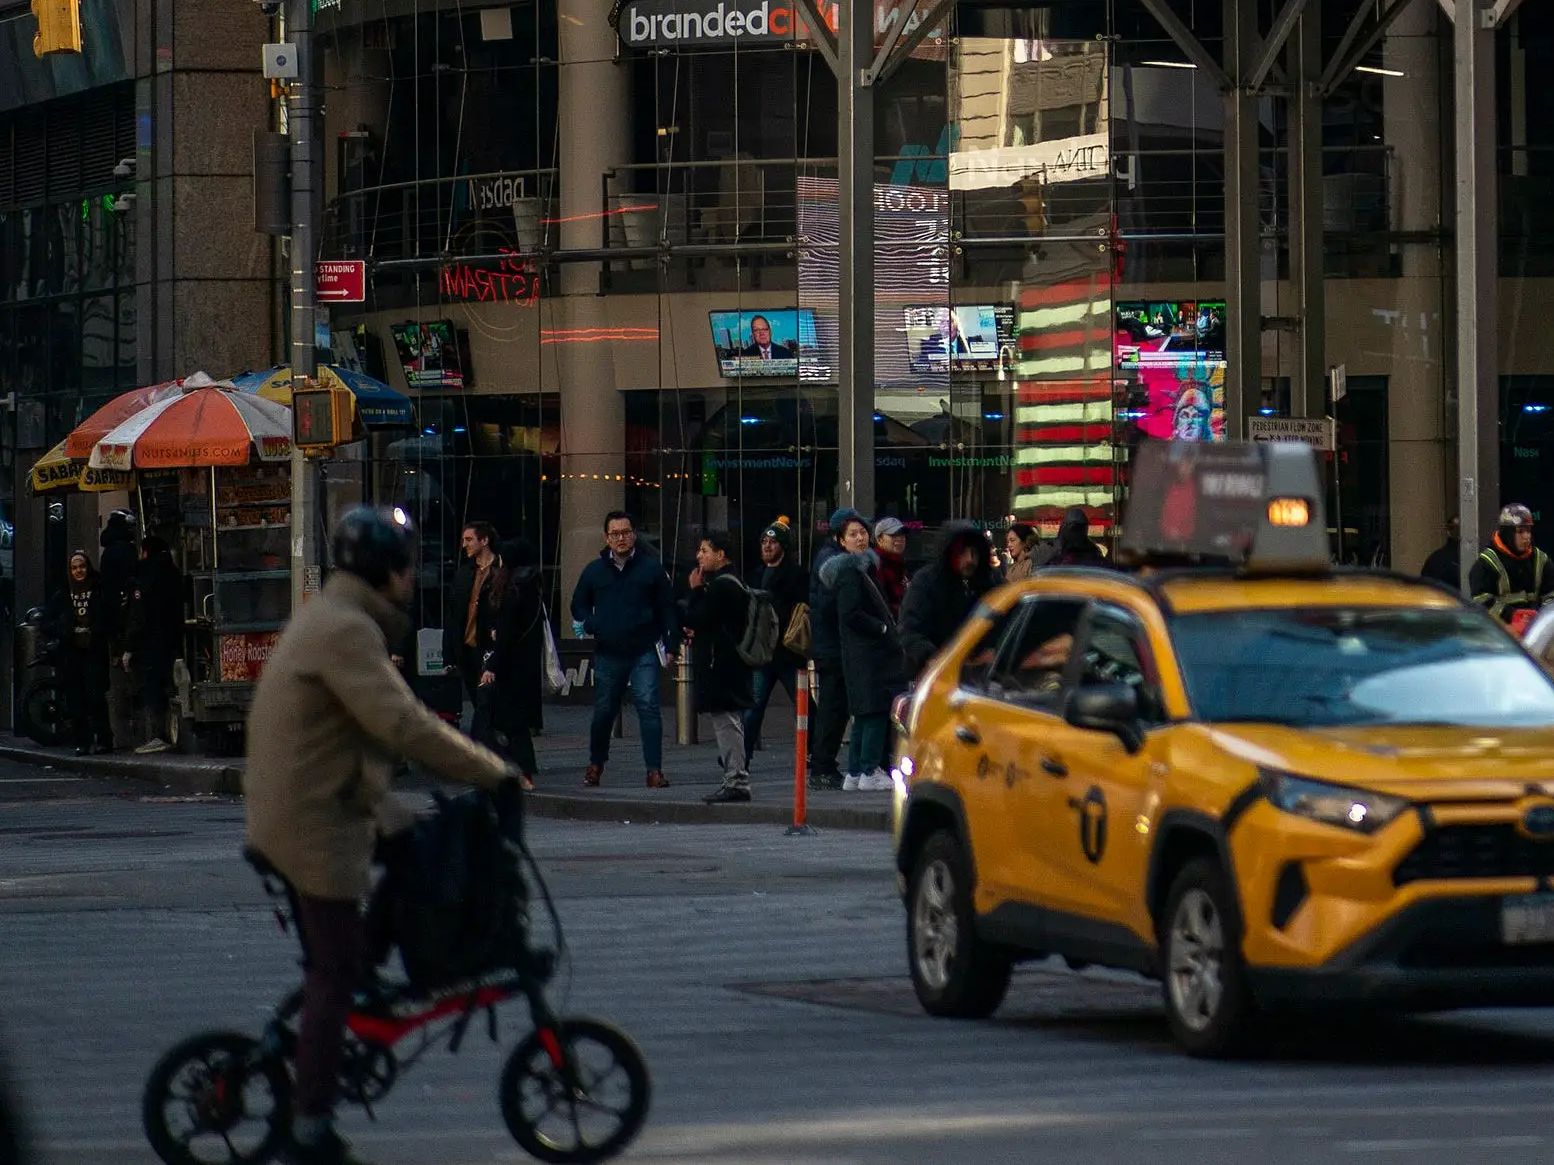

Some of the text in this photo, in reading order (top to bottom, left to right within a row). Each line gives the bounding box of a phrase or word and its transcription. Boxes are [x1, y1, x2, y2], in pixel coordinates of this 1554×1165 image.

[320, 265, 355, 273] STANDING
[317, 274, 338, 283] ytime
[1252, 421, 1324, 433] PEDESTRIAN FLOW ZONE
[142, 447, 241, 460] NUTS4NUTS.COM
[223, 642, 273, 663] Honey Roaste
